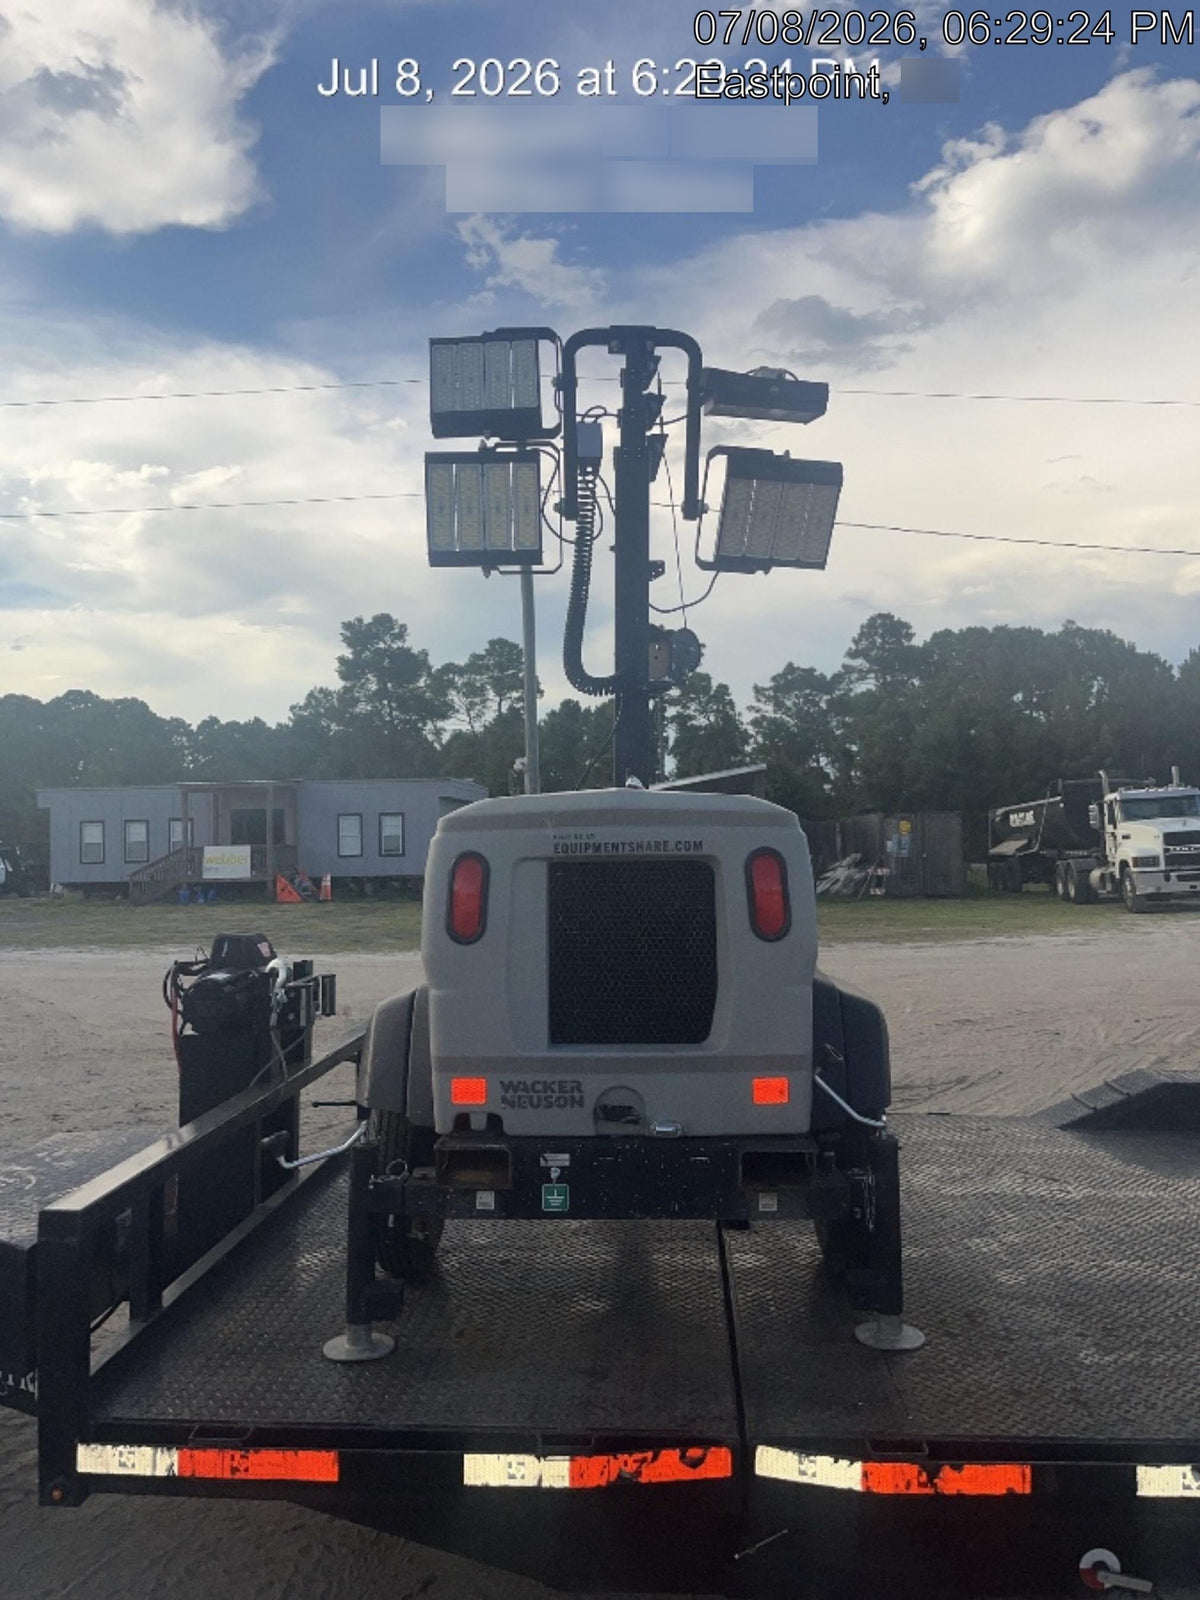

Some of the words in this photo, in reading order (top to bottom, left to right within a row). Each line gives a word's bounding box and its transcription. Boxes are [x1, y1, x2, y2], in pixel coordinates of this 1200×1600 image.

[553, 840, 703, 854] EQUIPMENTSHARE.COM
[499, 1080, 583, 1094] WACKER
[501, 1095, 584, 1109] NEUSON
